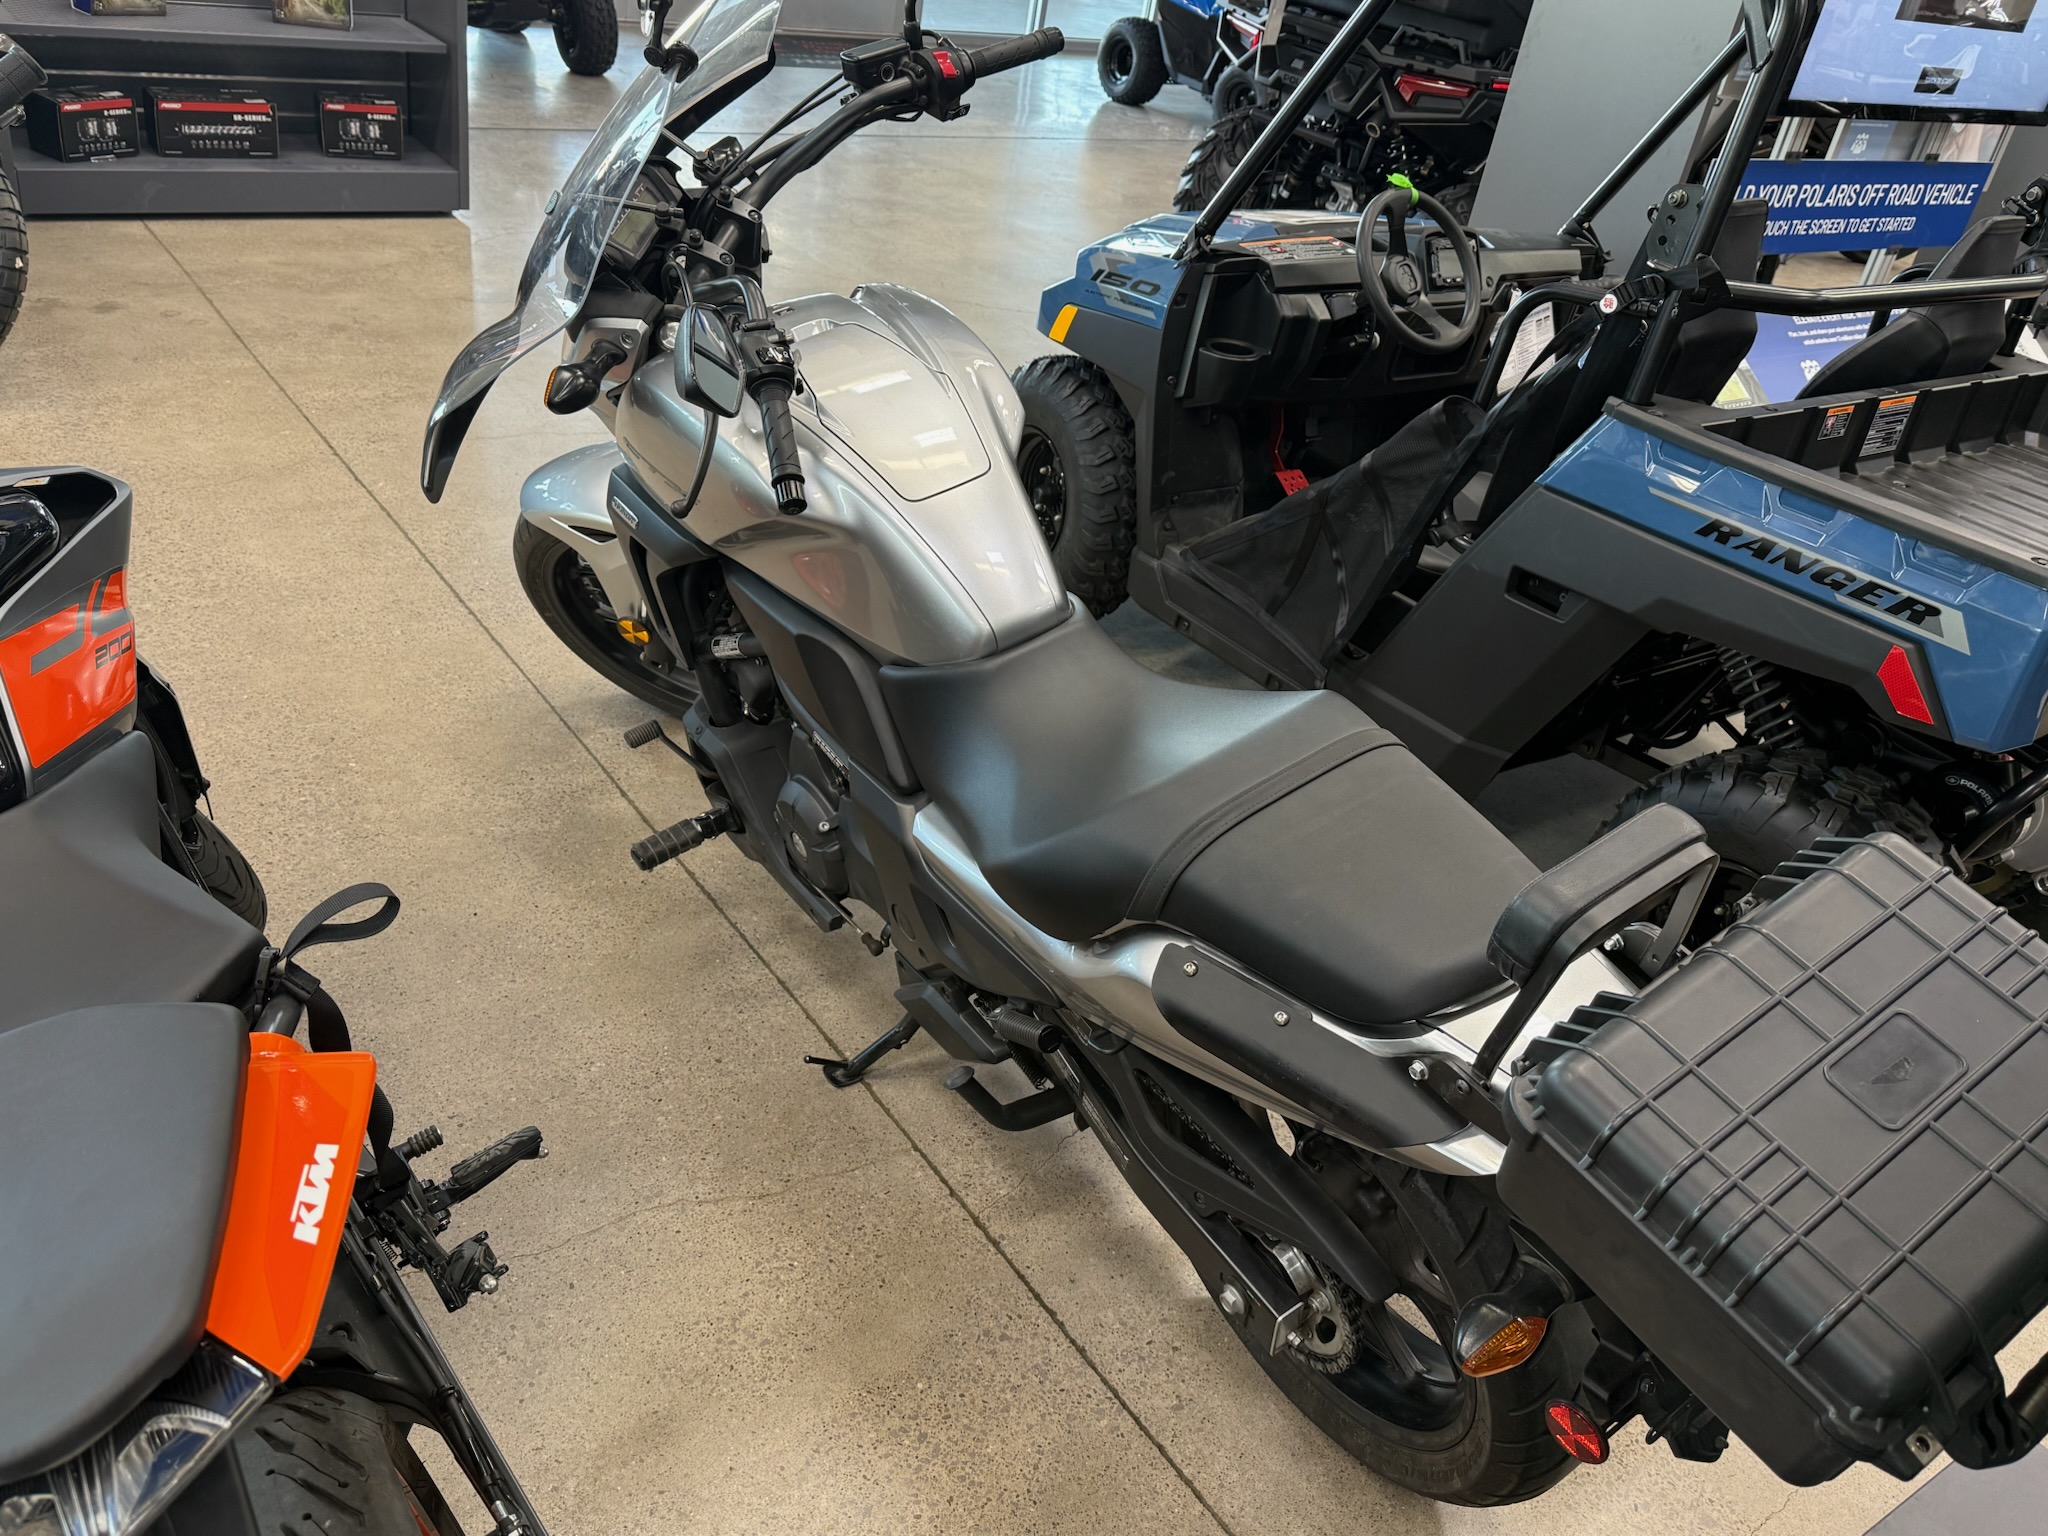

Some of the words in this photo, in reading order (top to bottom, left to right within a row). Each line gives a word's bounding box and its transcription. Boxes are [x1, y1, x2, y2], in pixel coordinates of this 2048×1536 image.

[1795, 183, 1860, 208] POLARIS
[1858, 183, 1890, 206] OFF
[1884, 183, 1925, 206] ROAD
[1922, 183, 1979, 206] VEHICLE
[1763, 220, 1791, 236] OUCH
[1789, 219, 1812, 236] THE
[1808, 218, 1848, 235] SCREEN
[1845, 218, 1861, 233] TO
[1858, 217, 1880, 233] GET
[1876, 216, 1917, 232] STARTED
[1090, 268, 1161, 297] 150
[1695, 519, 1942, 625] RANGER
[95, 630, 132, 670] 200
[289, 1143, 340, 1246] KTM
